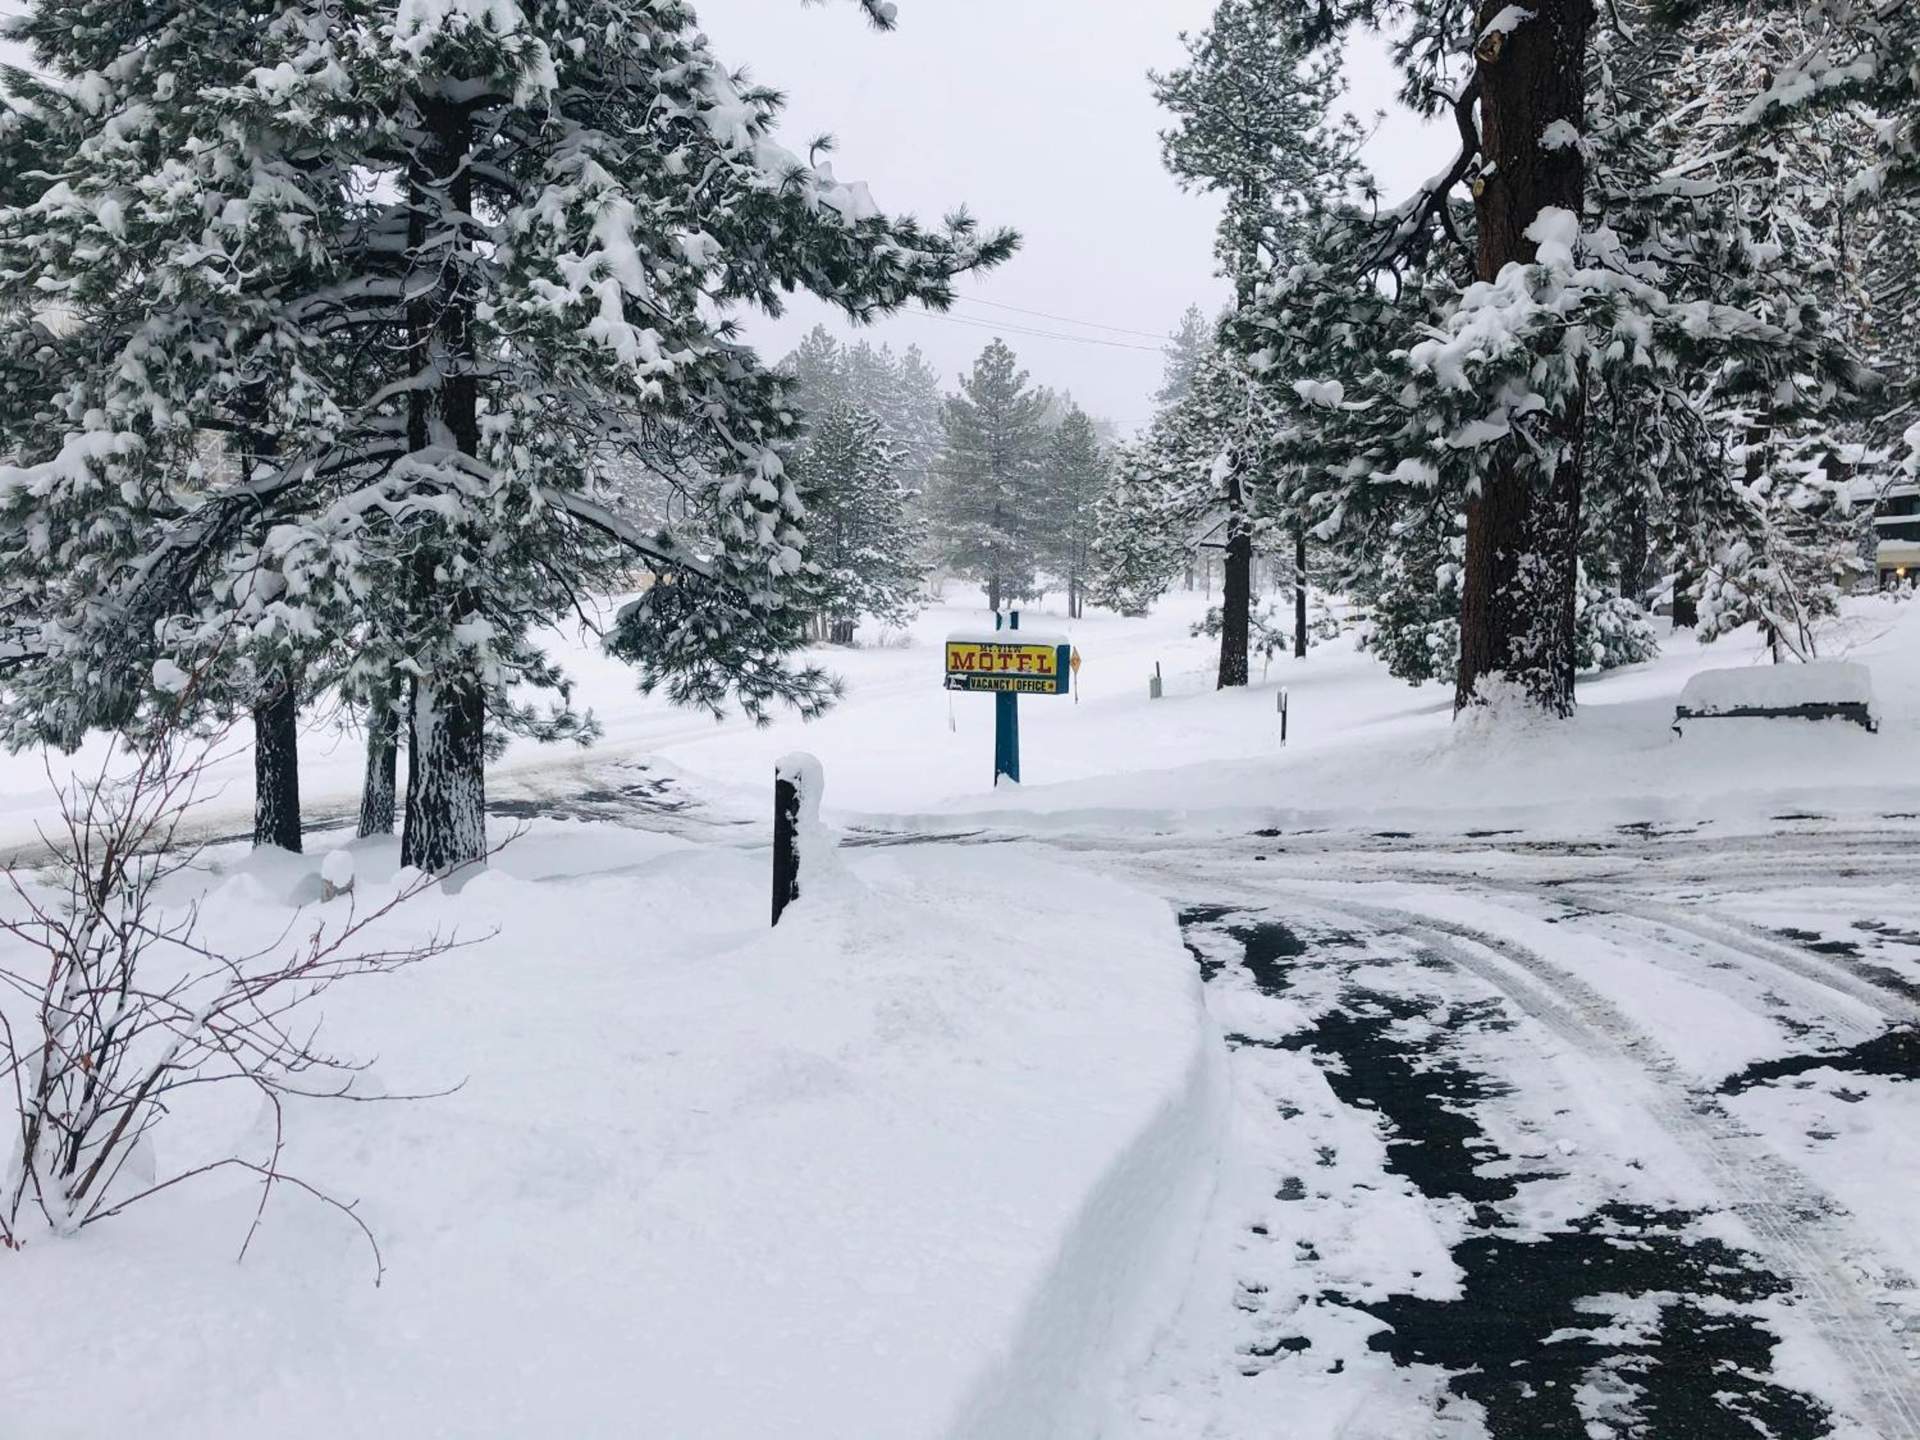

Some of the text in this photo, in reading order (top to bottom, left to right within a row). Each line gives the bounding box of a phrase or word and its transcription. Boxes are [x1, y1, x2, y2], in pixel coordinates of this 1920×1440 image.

[951, 651, 1052, 673] MOTEL
[971, 678, 1047, 691] VACANCY OFFICE
